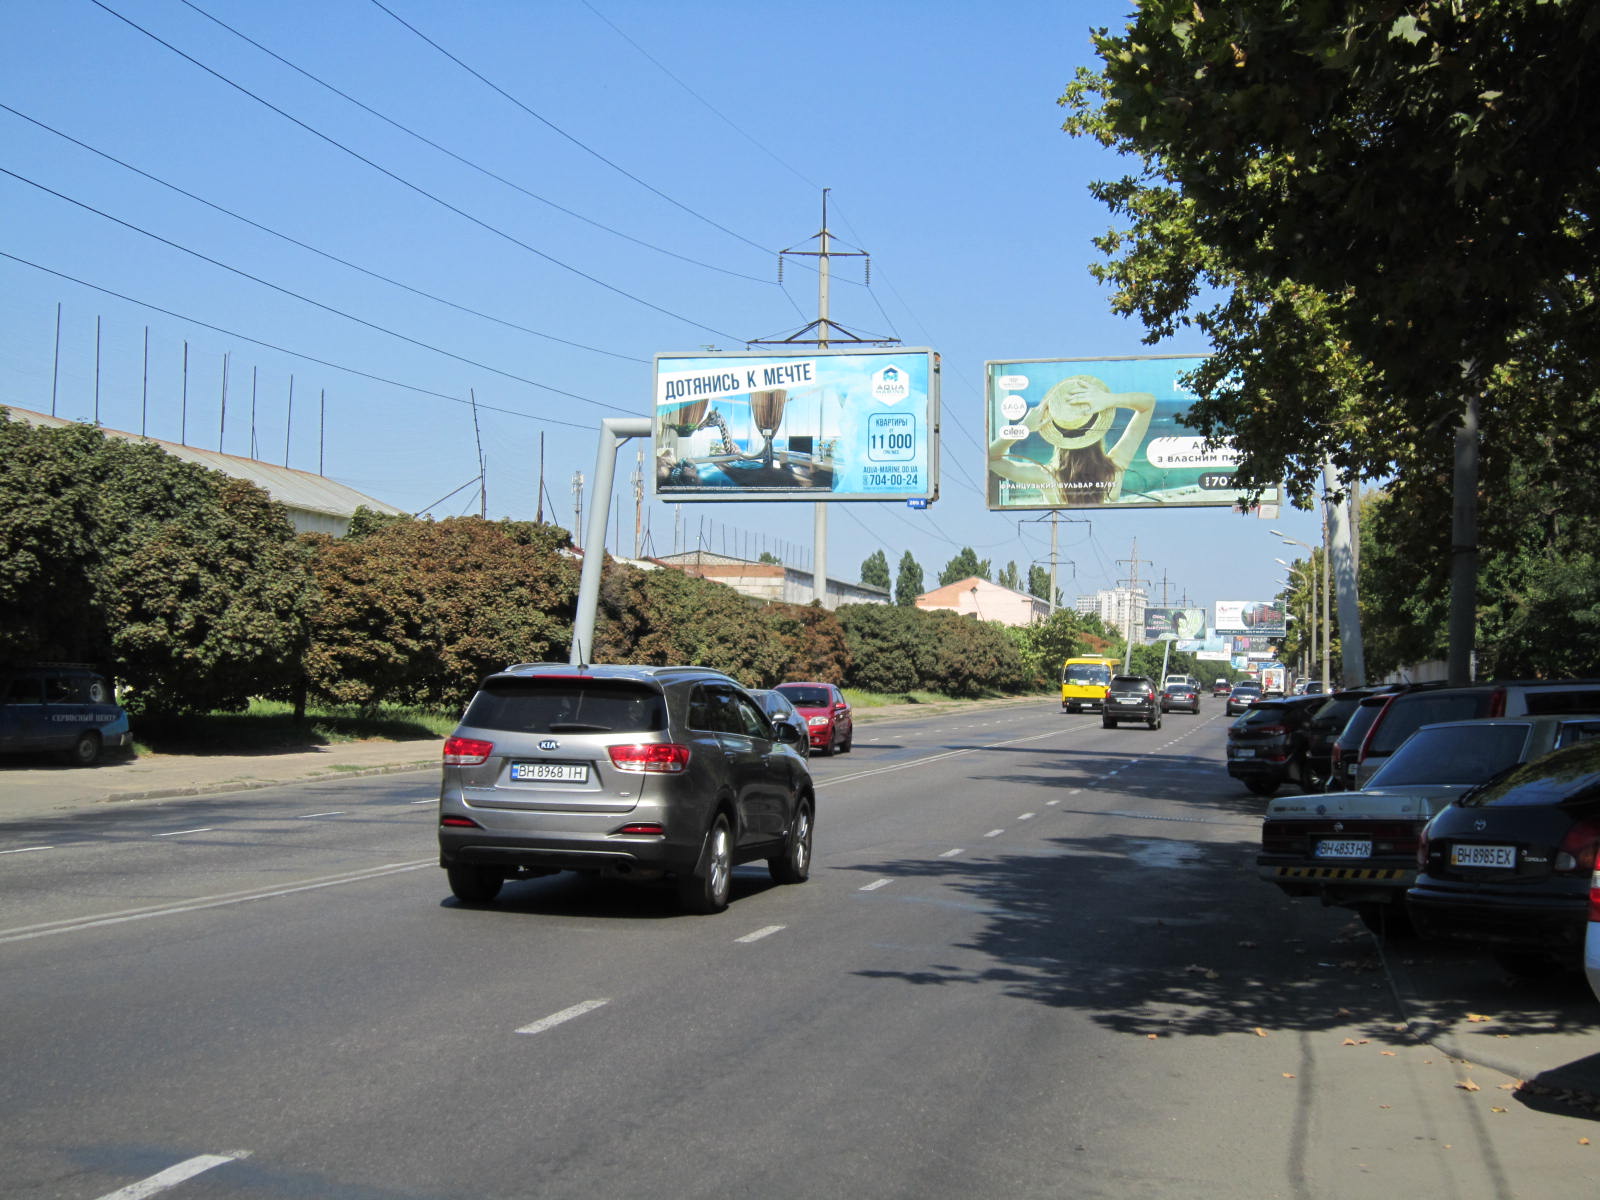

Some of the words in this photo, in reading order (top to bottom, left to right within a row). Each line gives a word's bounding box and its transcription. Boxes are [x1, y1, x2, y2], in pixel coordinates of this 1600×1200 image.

[665, 373, 740, 400] ДОТЯНИСЬ
[747, 370, 757, 388] К
[763, 363, 812, 386] МЕЧТЕ
[875, 418, 908, 427] КВАРТИРЫ
[1167, 453, 1217, 463] власним
[870, 474, 918, 486] 704-00-24
[1000, 482, 1056, 490] ФРАНЦУЗЬКИЙ
[1058, 481, 1093, 489] БУЛЬВАР
[540, 741, 556, 749] KIA
[519, 765, 535, 777] BH
[537, 766, 563, 778] 8968
[1457, 847, 1472, 863] BH
[1496, 849, 1511, 865] EX
